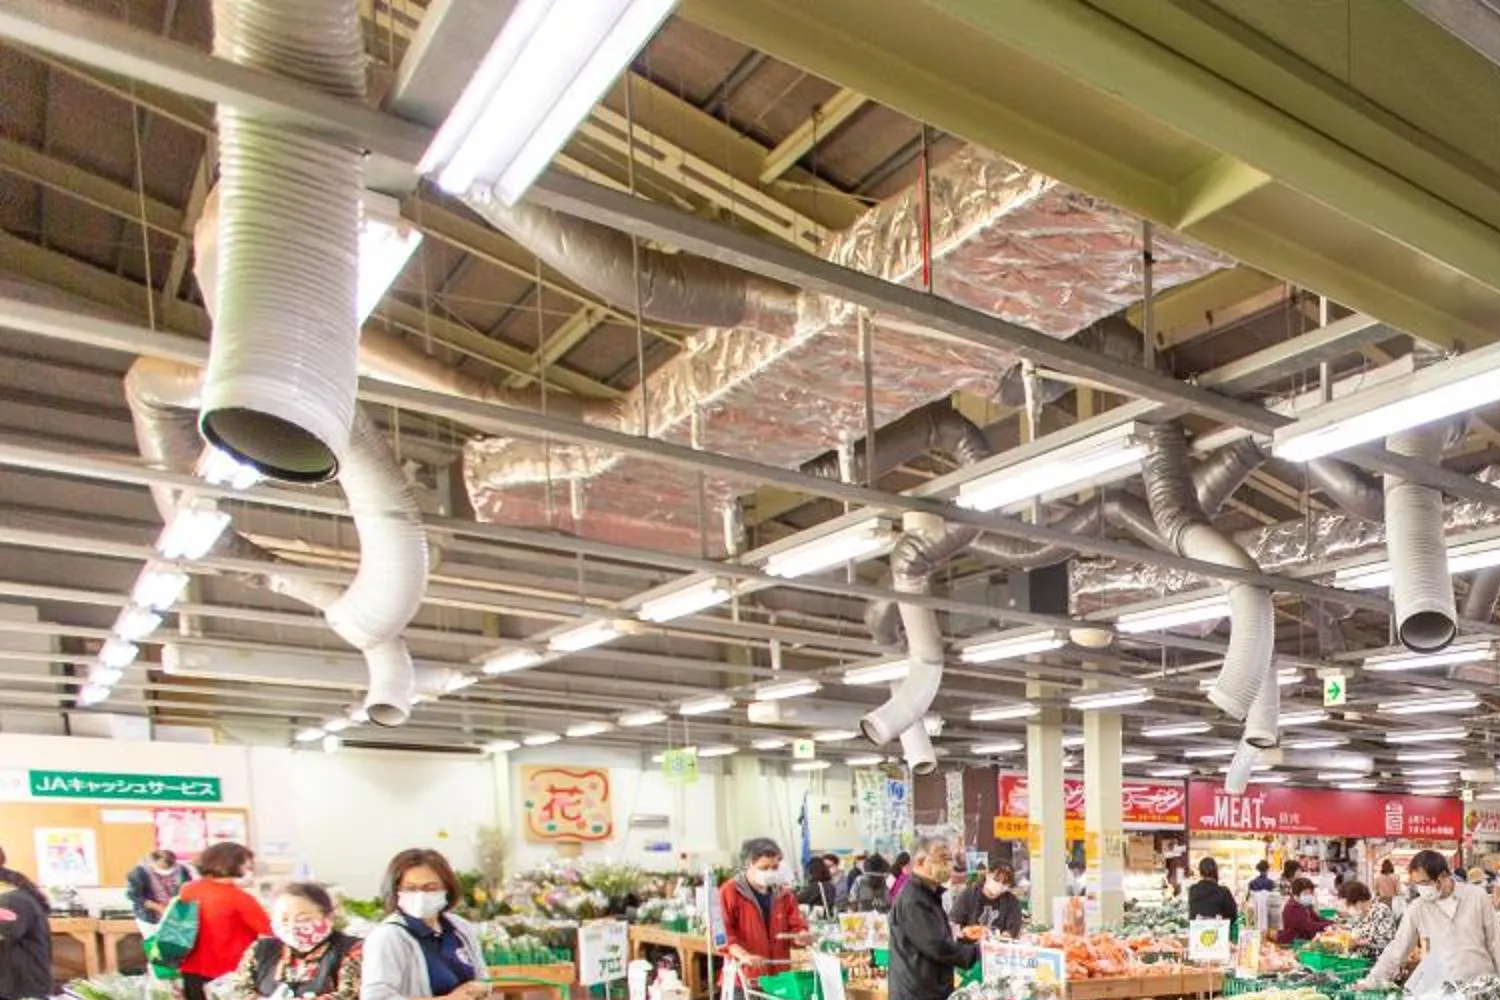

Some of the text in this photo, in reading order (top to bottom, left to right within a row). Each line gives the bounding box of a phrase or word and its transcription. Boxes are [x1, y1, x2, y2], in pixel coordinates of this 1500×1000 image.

[35, 776, 216, 796] JAキャッシュサービス
[1214, 794, 1265, 829] MEAT
